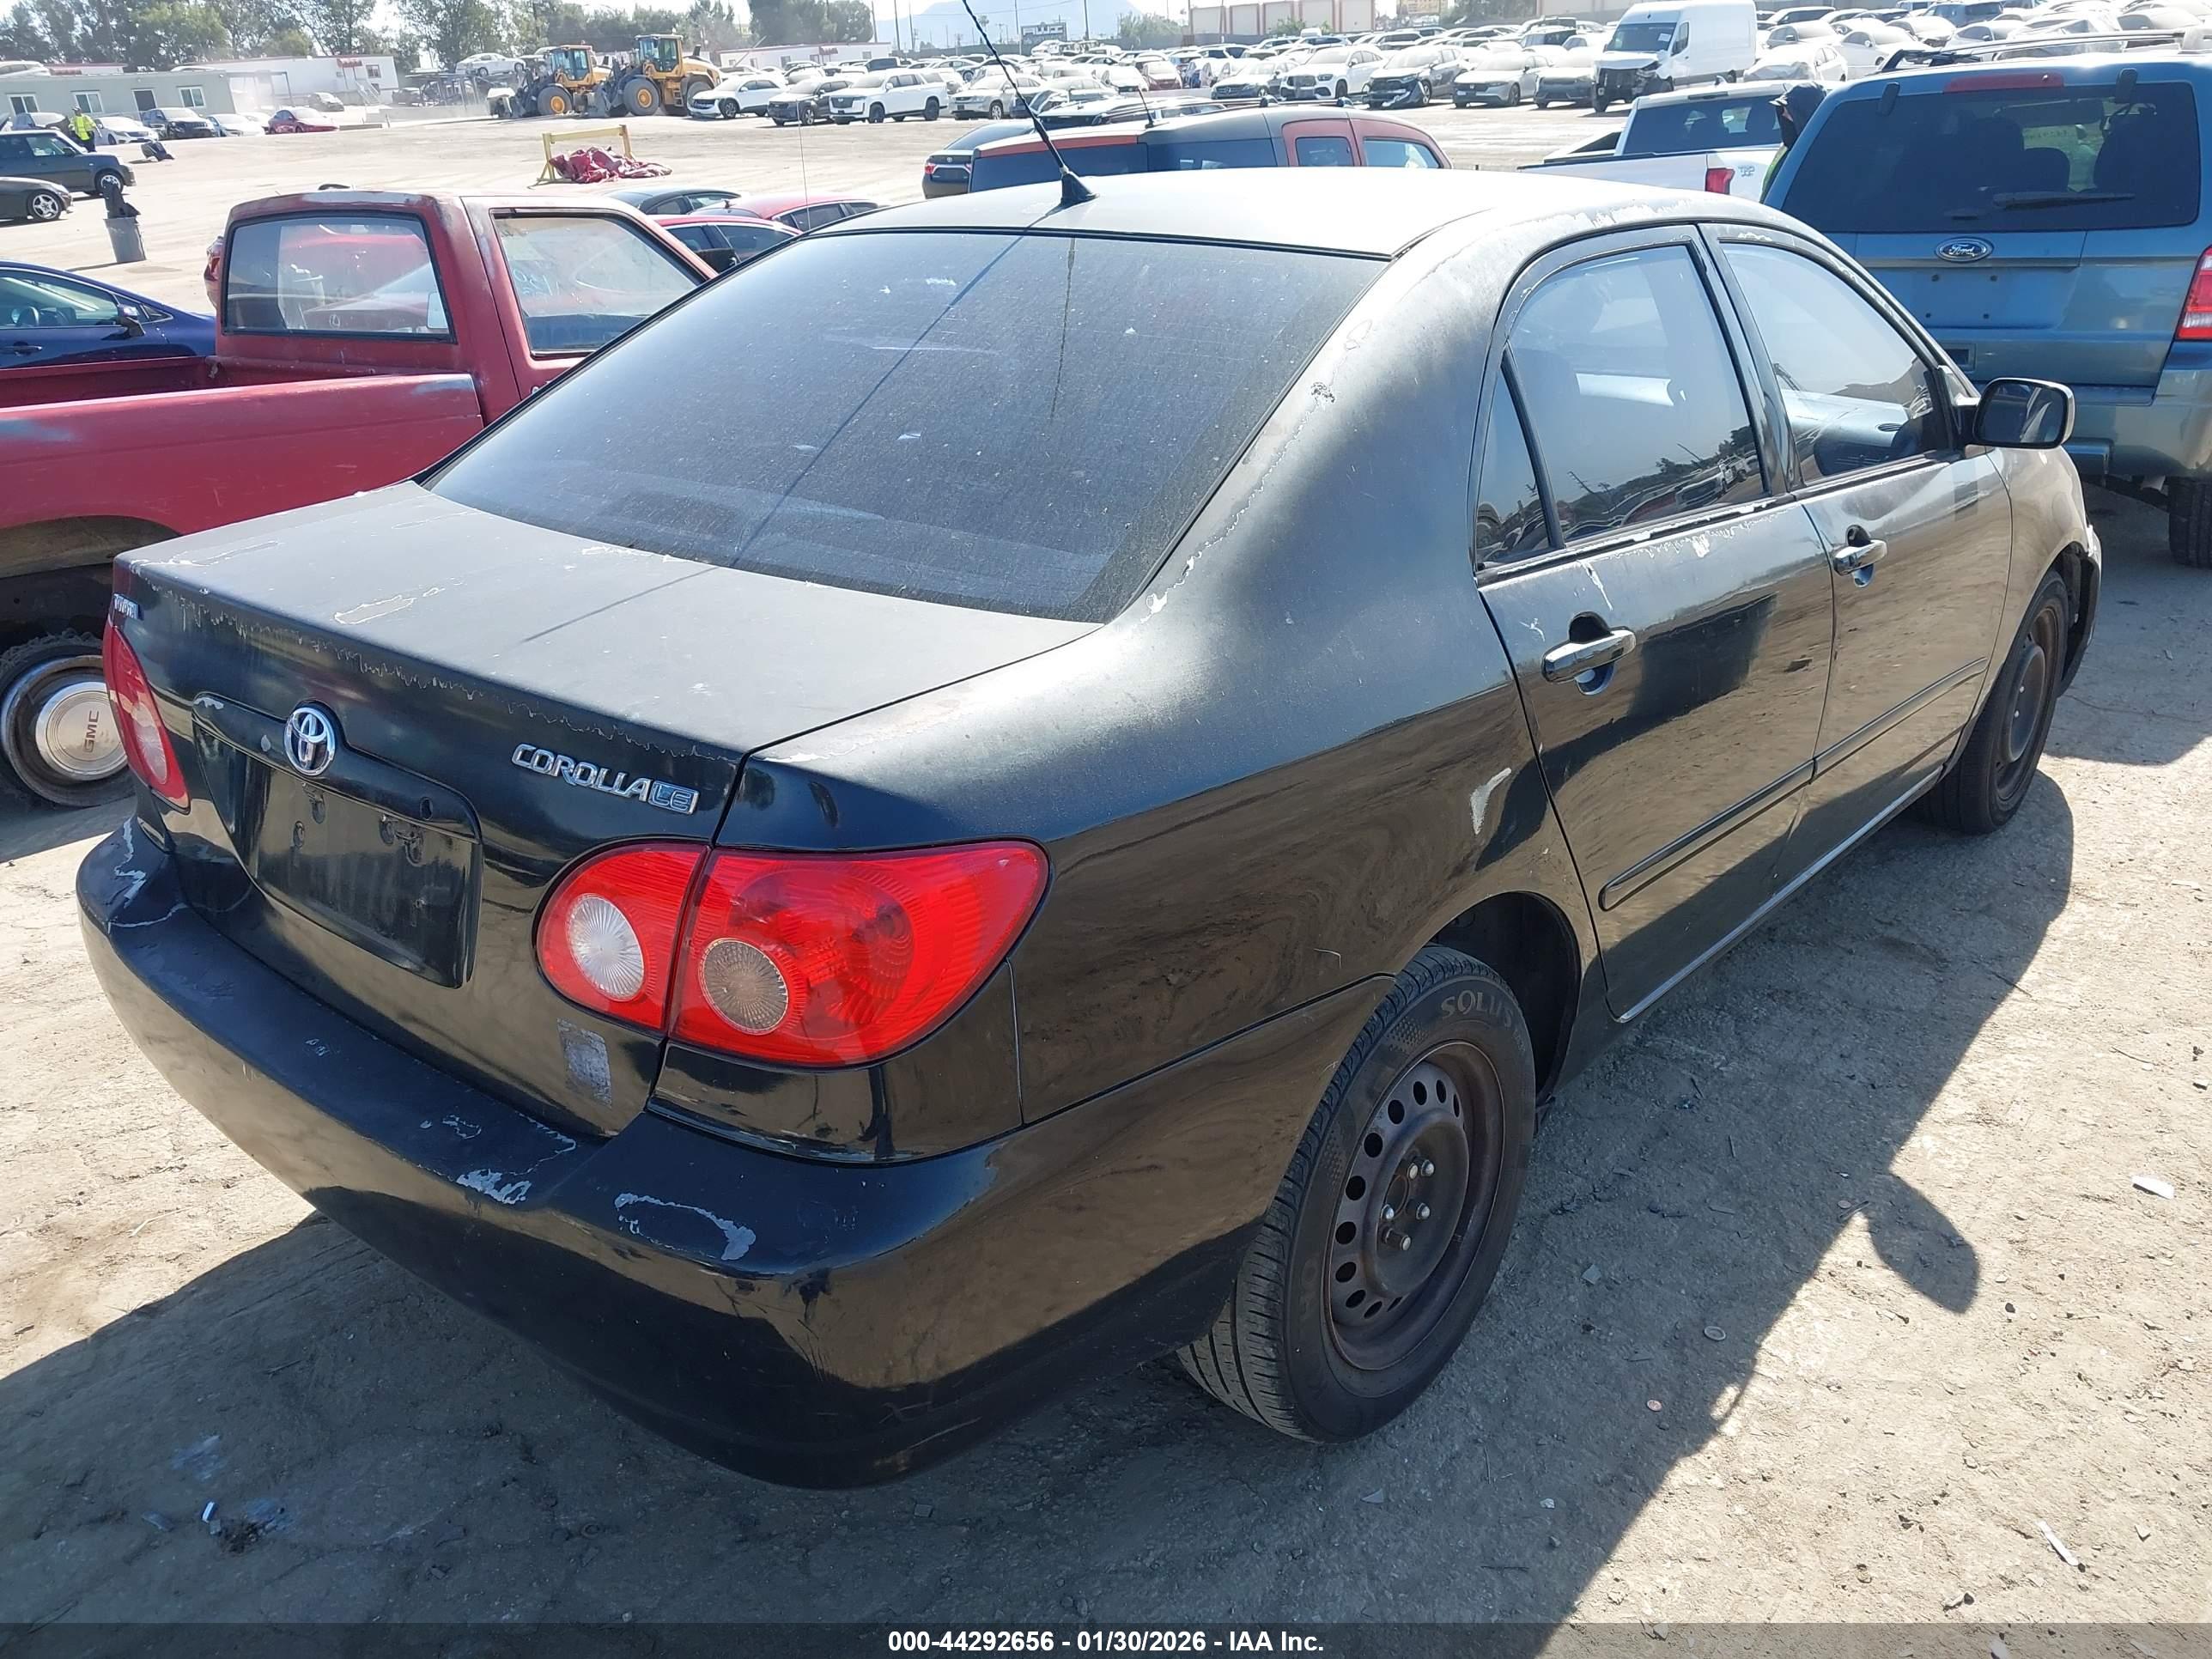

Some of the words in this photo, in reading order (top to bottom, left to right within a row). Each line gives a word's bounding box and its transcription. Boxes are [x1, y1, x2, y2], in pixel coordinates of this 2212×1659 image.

[1948, 243, 1978, 258] Ford
[83, 710, 100, 753] GMC
[511, 743, 653, 803] COROLLA
[650, 781, 697, 814] LE
[1440, 989, 1514, 1028] SOLUS
